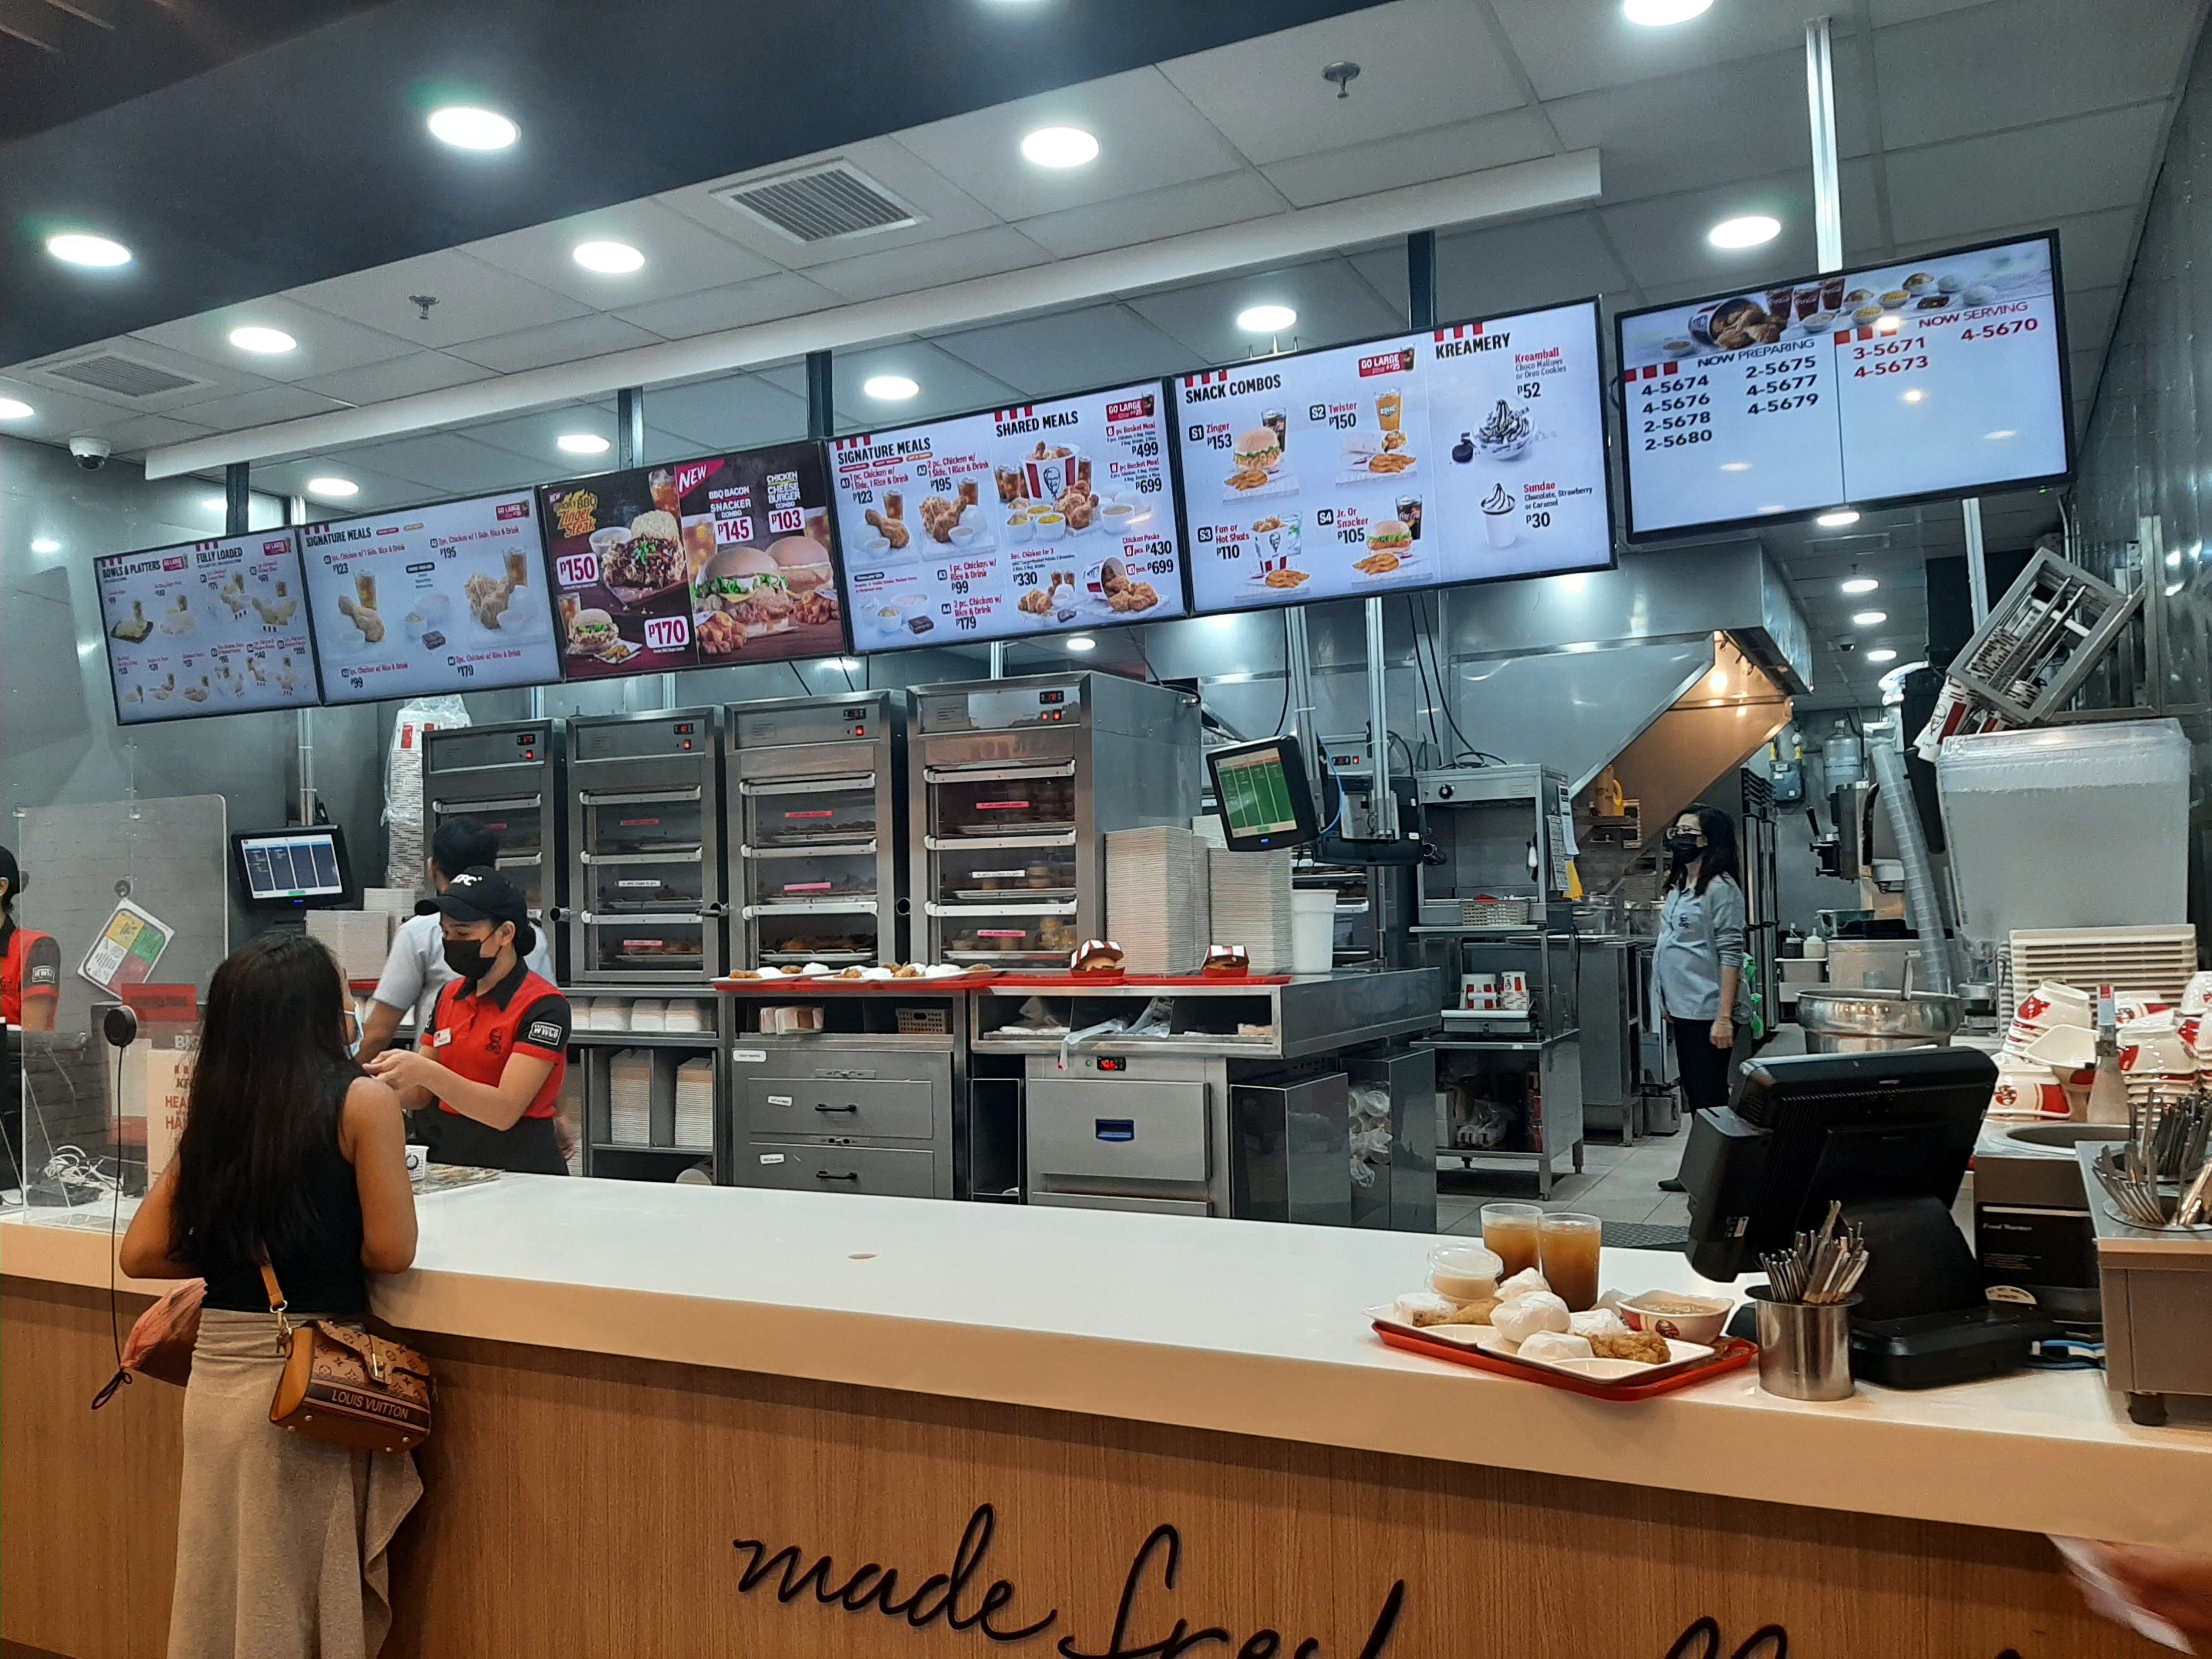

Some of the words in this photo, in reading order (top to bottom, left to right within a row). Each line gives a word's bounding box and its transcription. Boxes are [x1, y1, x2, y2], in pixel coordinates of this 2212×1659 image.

[1920, 313, 1960, 328] NOW
[1963, 302, 2028, 320] SERVING
[1961, 318, 2038, 341] 4-5670
[1436, 332, 1510, 359] KREAMERY
[1697, 354, 1734, 368] NOW
[1739, 338, 1815, 360] PREPARING
[1853, 337, 1925, 360] 3-5671
[1361, 360, 1372, 369] GO
[1374, 354, 1399, 367] LARGE
[1515, 347, 1559, 363] Kreamball
[1516, 363, 1535, 371] Choco
[1541, 365, 1566, 375] Cookies
[1746, 356, 1815, 379] 2-5675
[1854, 356, 1928, 377] 4-5673
[1186, 383, 1226, 404] SNACK
[1229, 374, 1282, 396] COMBOS
[1641, 375, 1709, 396] 4-5674
[1746, 374, 1818, 396] 4-5677
[1109, 405, 1118, 414] GO
[1120, 400, 1141, 411] LARGE
[1328, 402, 1357, 414] Twister
[1642, 393, 1711, 414] 4-5676
[1748, 393, 1819, 414] 4-5679
[1312, 406, 1324, 419] S2
[996, 418, 1040, 437] SHARED
[1042, 410, 1079, 429] MEALS
[1206, 423, 1229, 433] Zinger
[1644, 411, 1711, 433] 2-5678
[1192, 427, 1203, 439] S1
[1645, 430, 1712, 451] 2-5680
[838, 444, 894, 465] SIGNATURE
[897, 437, 931, 455] MEALS
[943, 455, 967, 466] Chicken
[679, 465, 707, 493] NEW
[766, 471, 798, 484] CHICKEN
[709, 489, 724, 500] BBQ
[724, 486, 749, 498] BACON
[768, 482, 799, 494] CHEESE
[1523, 481, 1555, 493] Sundae
[1558, 487, 1593, 497] Strawberry
[577, 496, 597, 510] BBQ
[768, 492, 800, 504] BURGER
[1533, 499, 1558, 509] Caramel
[710, 499, 752, 513] SNACKER
[1337, 509, 1346, 517] Jr.
[1348, 507, 1357, 516] Or
[560, 509, 591, 527] Zinger
[1319, 511, 1332, 523] S4
[1337, 517, 1369, 528] Snacker
[565, 518, 596, 538] Steak
[1199, 529, 1211, 541] S3
[1215, 525, 1228, 534] Fun
[306, 533, 346, 548] SIGNATURE
[347, 527, 372, 541] MEALS
[1216, 535, 1228, 544] Hot
[1229, 533, 1250, 543] Shots
[196, 551, 216, 563] FULLY
[216, 547, 242, 559] LOADED
[103, 566, 123, 578] BOWLS
[130, 560, 161, 574] PLATTERS
[969, 596, 993, 606] Chicken
[176, 1077, 190, 1088] KF
[331, 1390, 363, 1408] LOUIS
[365, 1397, 409, 1419] VUITTON
[733, 1503, 1059, 1642] made
